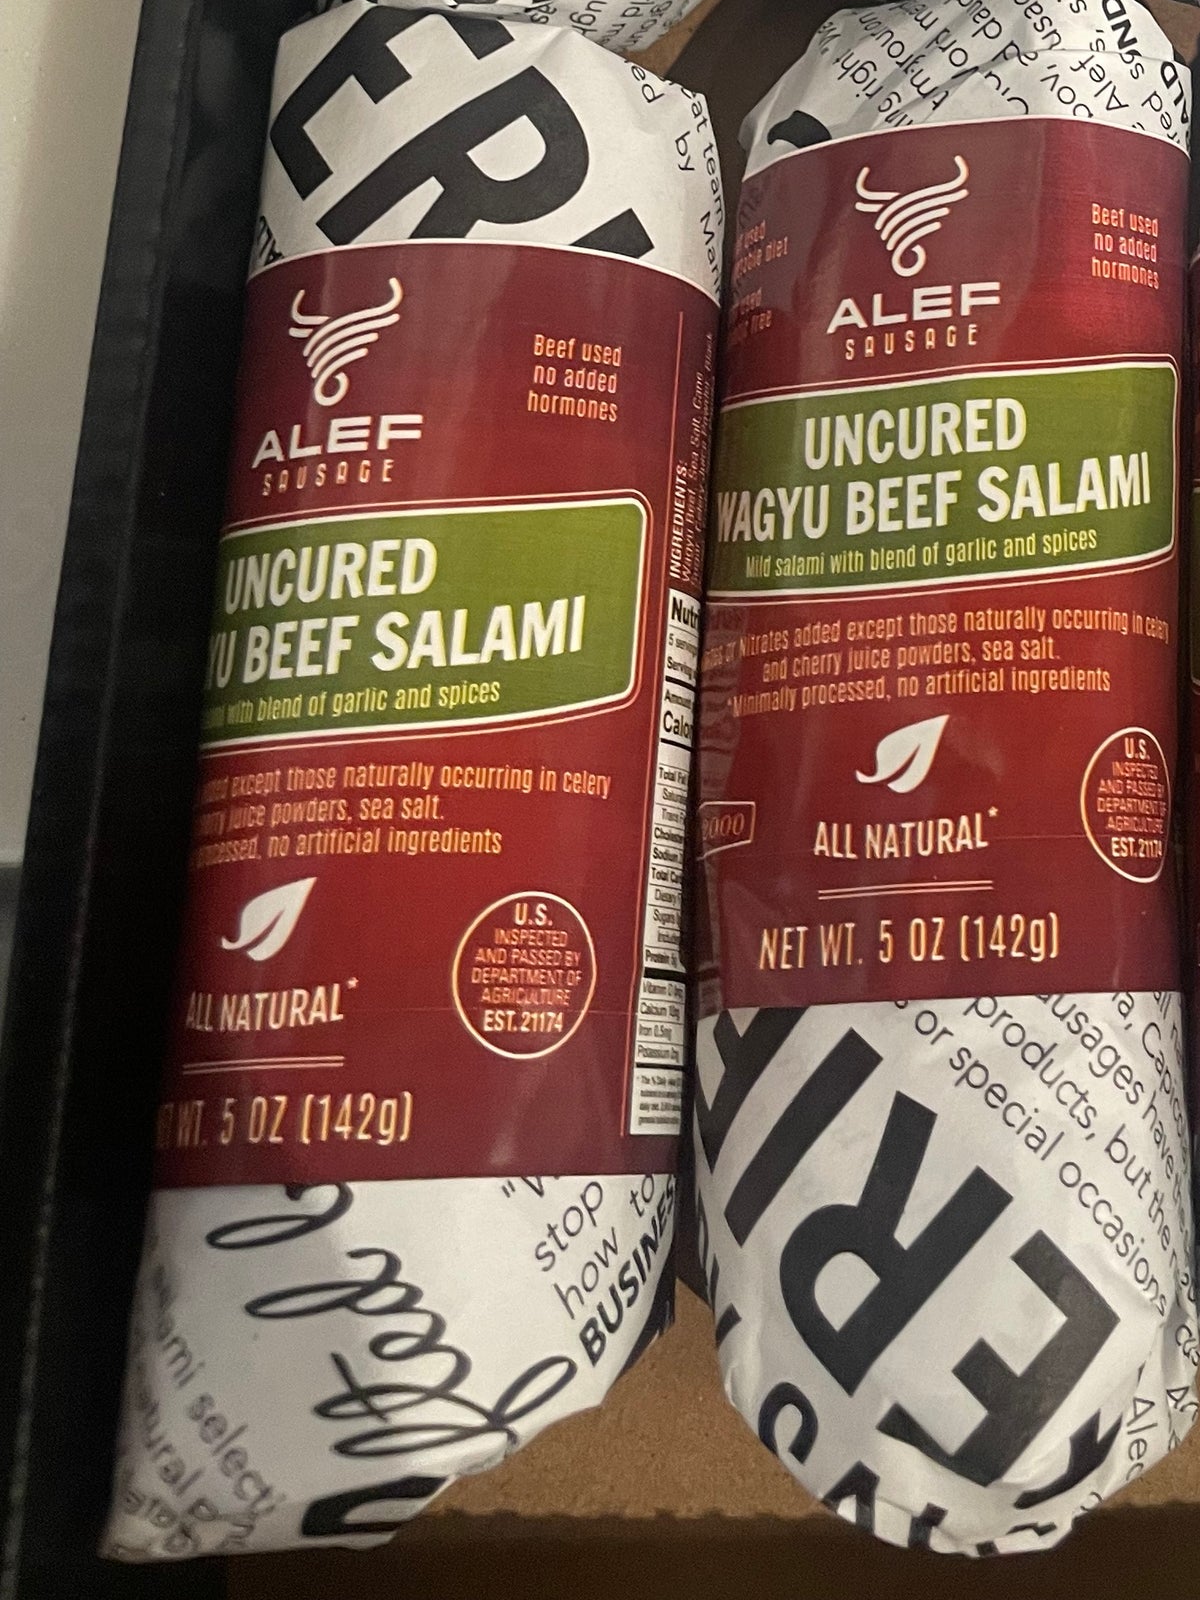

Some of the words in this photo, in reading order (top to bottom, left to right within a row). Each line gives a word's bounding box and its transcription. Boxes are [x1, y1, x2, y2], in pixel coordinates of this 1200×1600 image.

[826, 281, 1001, 335] ALEF
[527, 390, 618, 422] hormones
[804, 397, 1027, 470] UNCURED
[252, 414, 423, 469] ALEF
[845, 470, 963, 536] BEEF
[977, 452, 1151, 524] SALAMI
[225, 537, 437, 615] UNCURED
[946, 535, 998, 566] garlic
[1004, 534, 1036, 557] and
[1043, 527, 1097, 557] spices
[370, 595, 587, 673] SALAMI
[296, 829, 380, 856] artificial
[388, 827, 503, 857] ingredients
[759, 925, 808, 971] NET
[820, 922, 863, 967] WT.
[878, 920, 893, 963] 5
[909, 916, 944, 962] OZ
[960, 911, 1059, 963] (142g)
[248, 1096, 285, 1144] OZ
[948, 1046, 1065, 1162] special
[536, 1181, 603, 1272] stop
[554, 1227, 620, 1319] how
